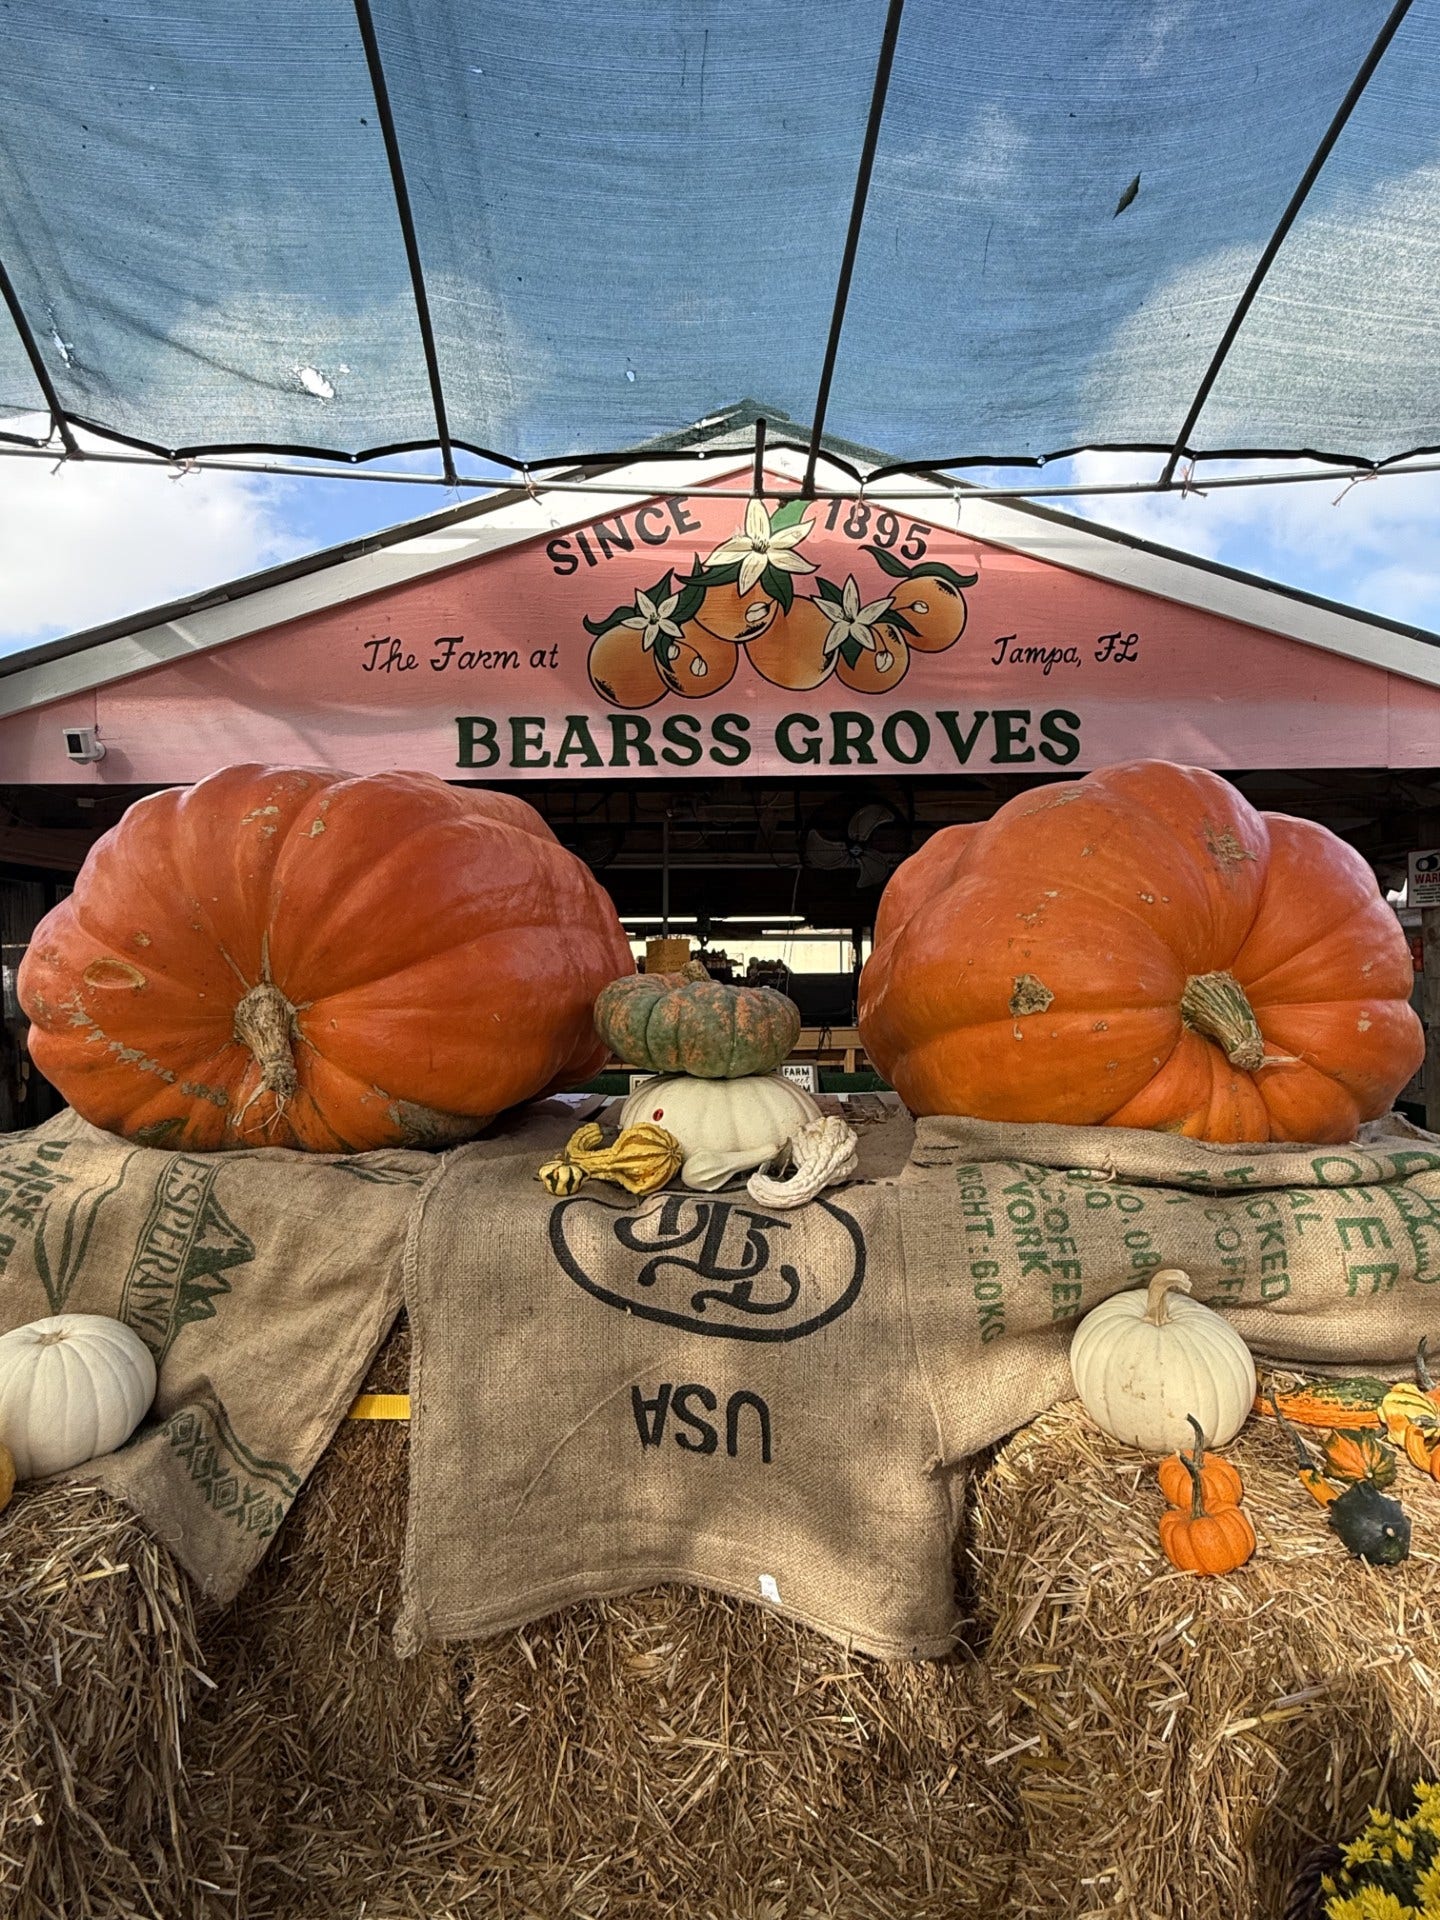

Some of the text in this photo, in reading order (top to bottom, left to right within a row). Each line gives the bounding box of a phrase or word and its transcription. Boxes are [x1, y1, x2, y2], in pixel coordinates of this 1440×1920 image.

[546, 496, 932, 576] SINCE 1895
[362, 635, 560, 674] The Farm at
[991, 631, 1139, 676] Tampa, FL
[456, 710, 1082, 768] BEARSS GROVES
[1414, 872, 1440, 885] WAR
[784, 1067, 810, 1076] FARM
[1001, 1180, 1052, 1277] YORK
[631, 1384, 771, 1463] USA
